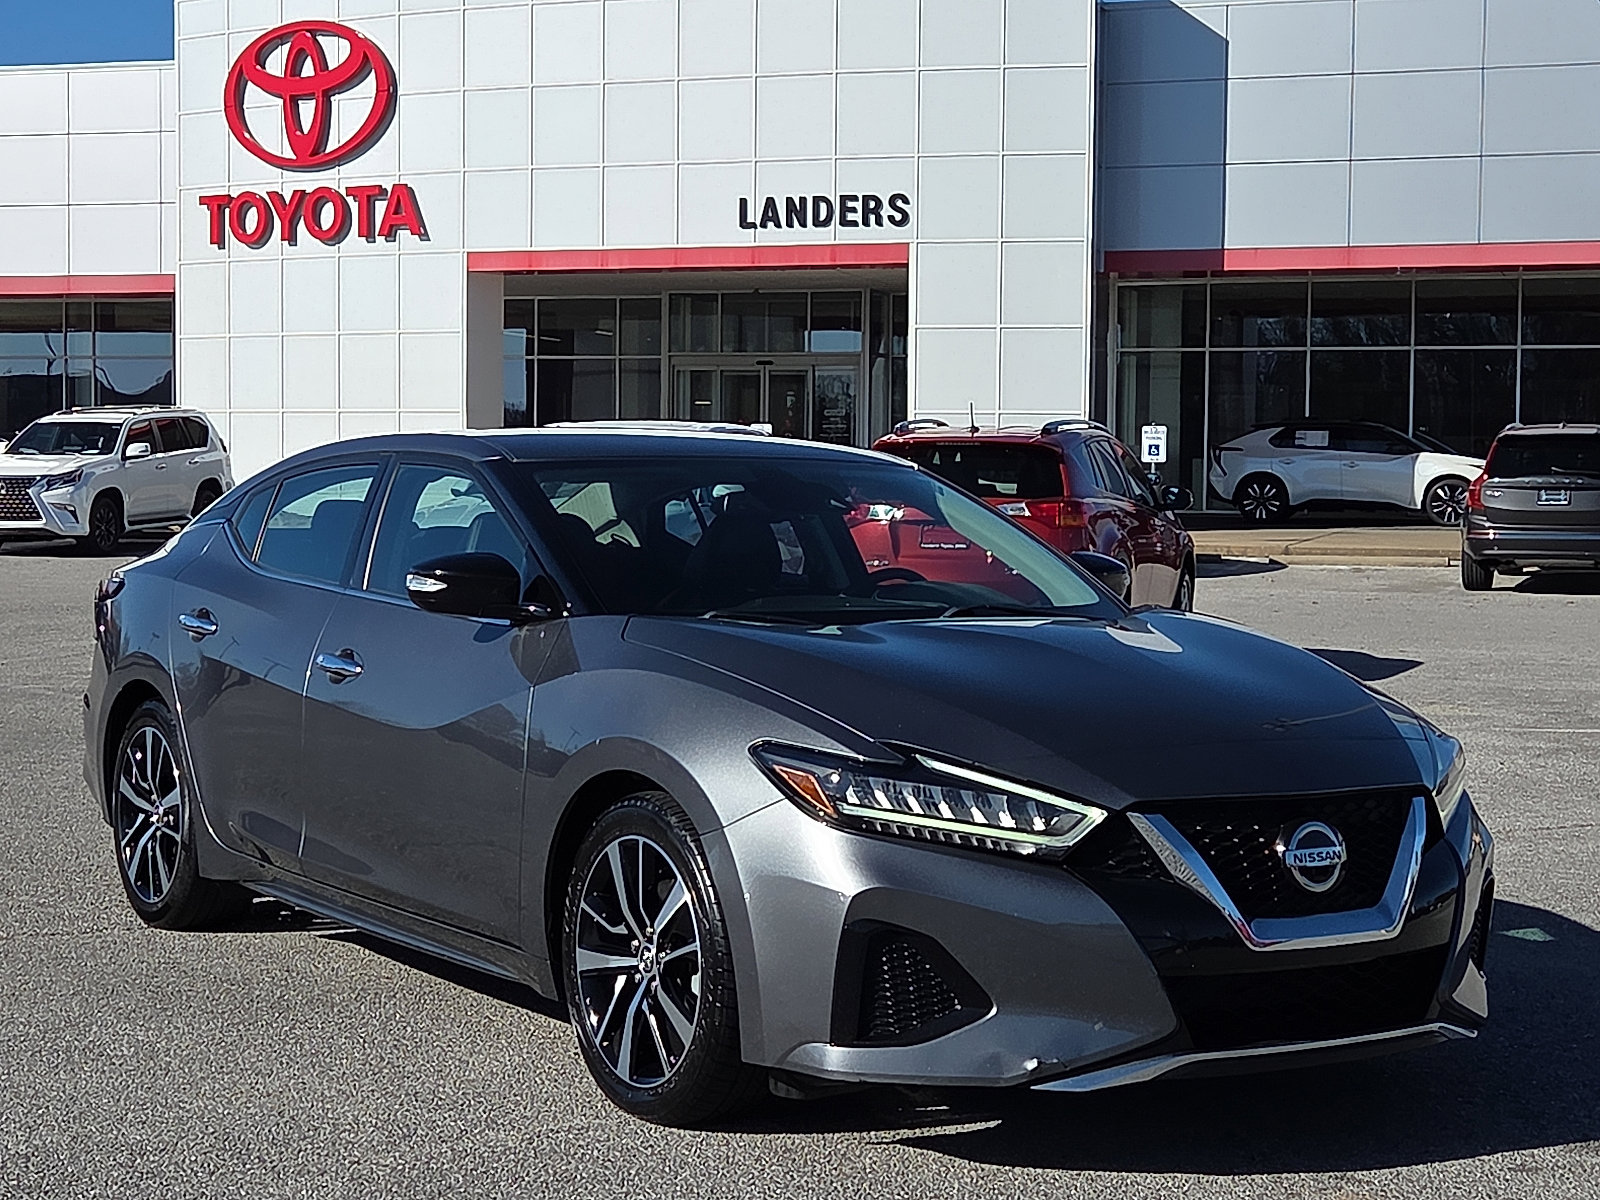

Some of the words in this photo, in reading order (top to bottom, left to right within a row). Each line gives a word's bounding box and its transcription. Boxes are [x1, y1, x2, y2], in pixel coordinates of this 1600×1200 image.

[199, 183, 430, 249] TOYOTA
[738, 193, 911, 230] LANDERS
[1293, 850, 1341, 864] NISSAN
